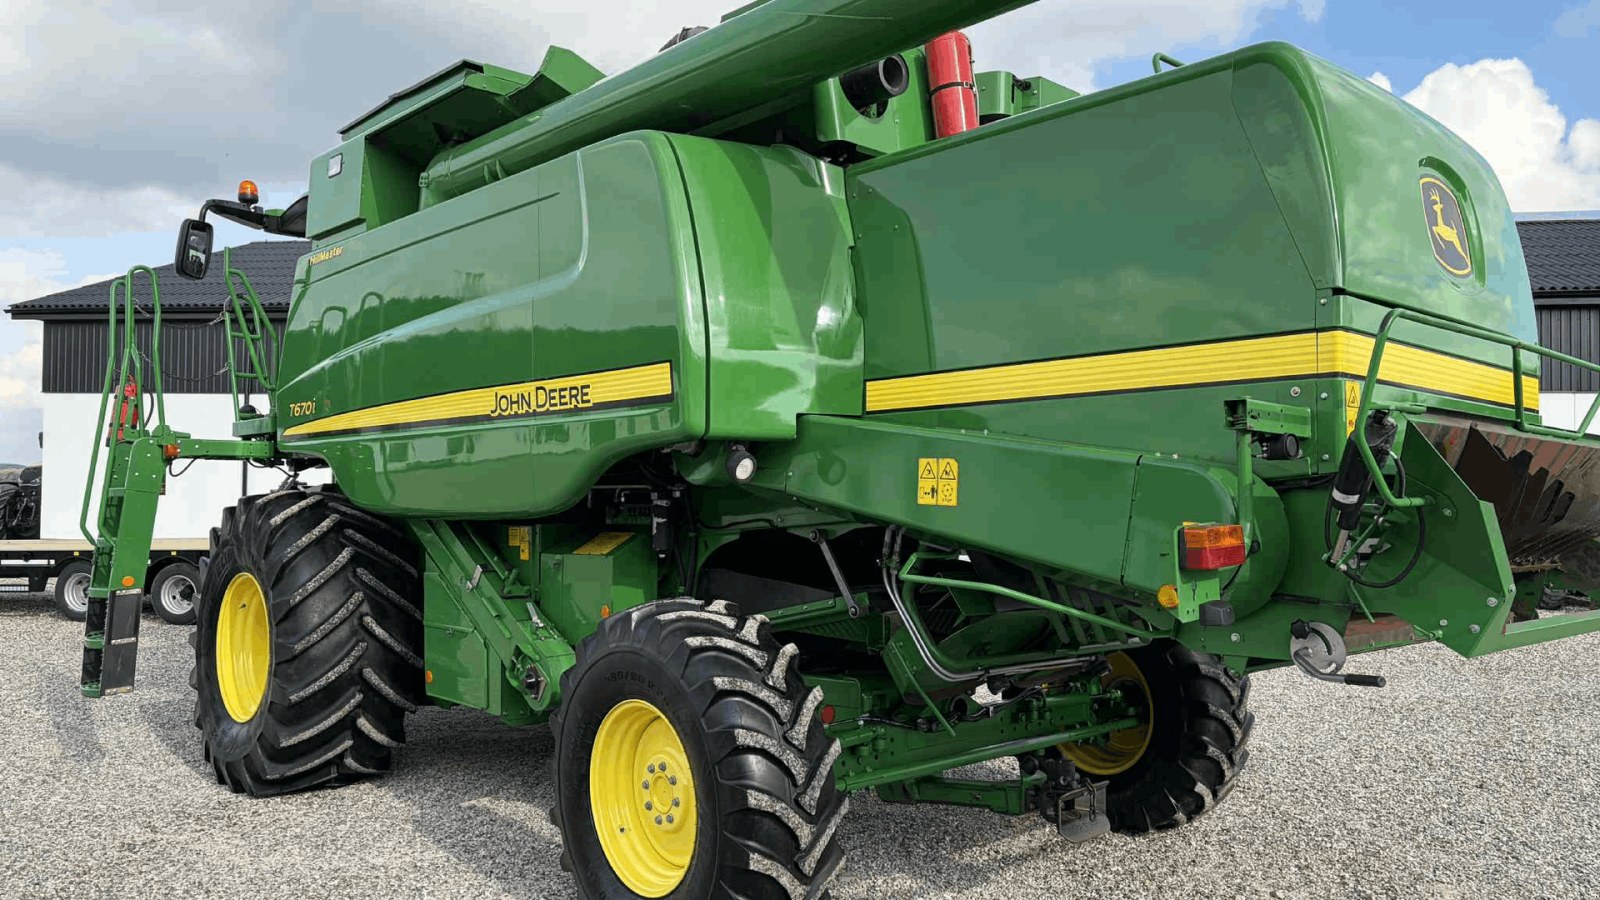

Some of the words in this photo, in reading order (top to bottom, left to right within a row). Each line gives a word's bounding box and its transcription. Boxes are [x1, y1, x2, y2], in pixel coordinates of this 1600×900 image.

[289, 397, 316, 417] T670i
[490, 391, 532, 414] JOHN
[535, 384, 592, 409] DEERE
